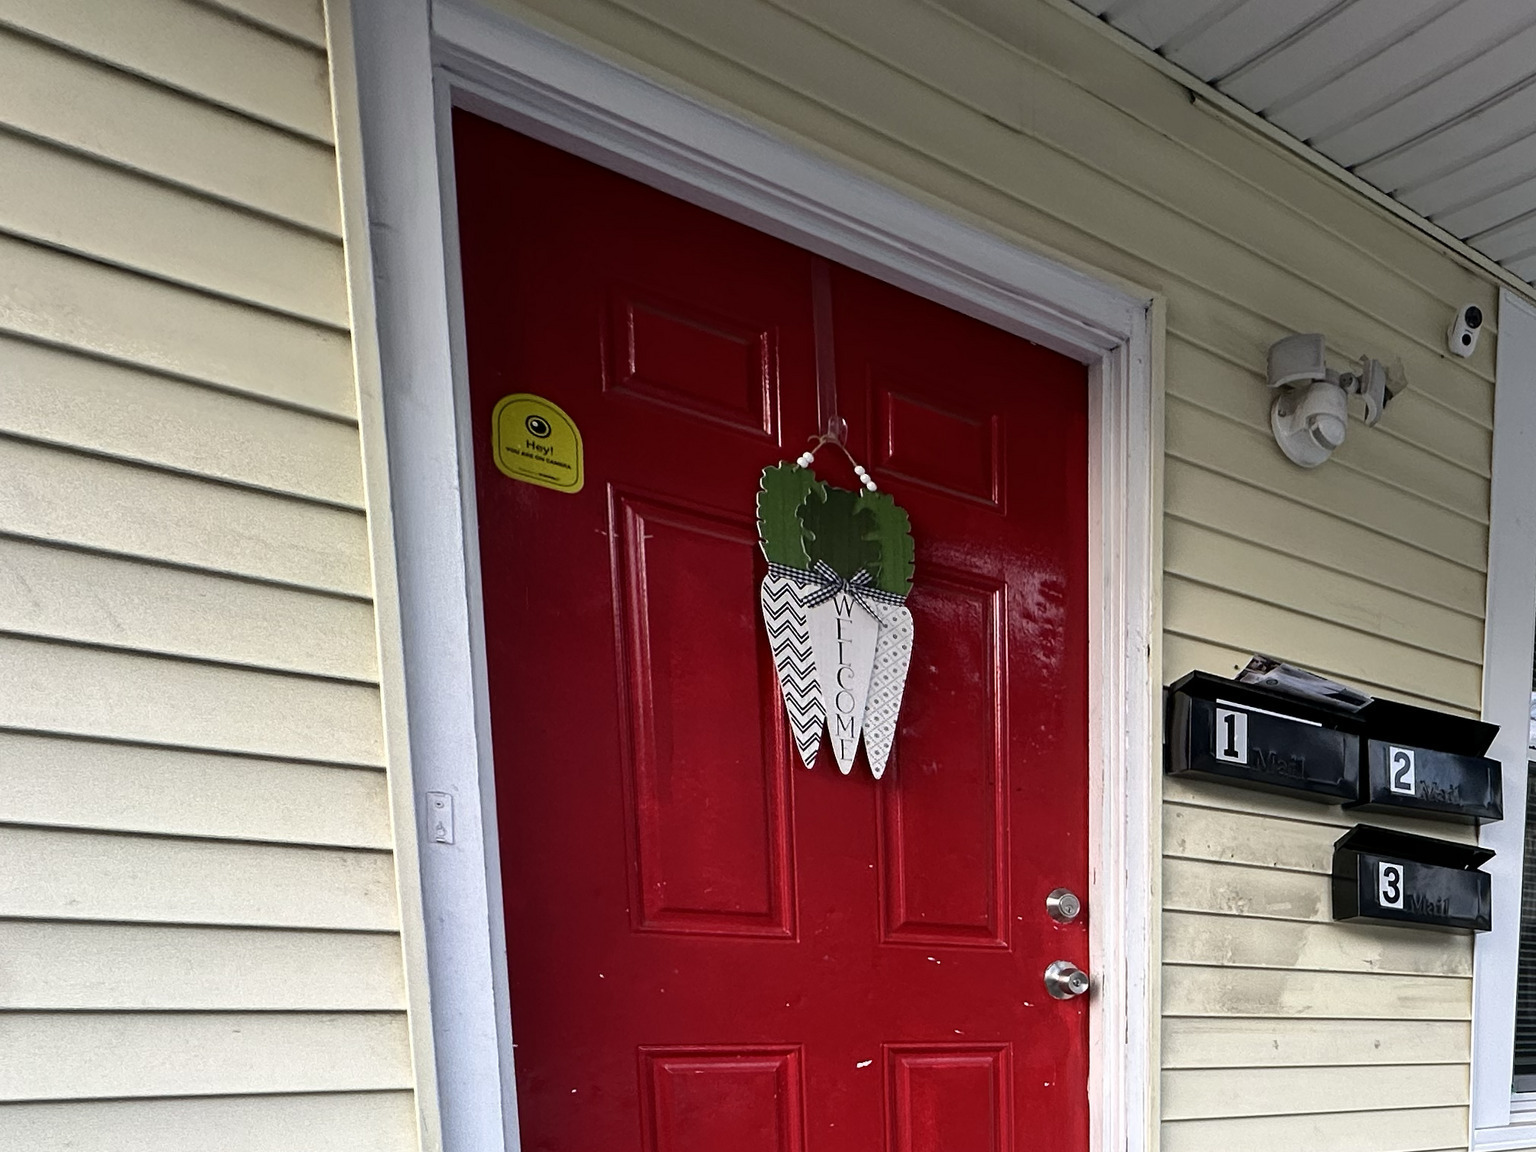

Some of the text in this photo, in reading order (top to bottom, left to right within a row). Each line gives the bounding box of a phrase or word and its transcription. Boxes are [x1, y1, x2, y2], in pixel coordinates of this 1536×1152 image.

[526, 439, 554, 456] Hey!
[833, 594, 856, 762] WELCOME
[1223, 713, 1239, 759] 1
[1251, 746, 1306, 780] Mail
[1393, 751, 1412, 791] 2
[1382, 866, 1401, 904] 3
